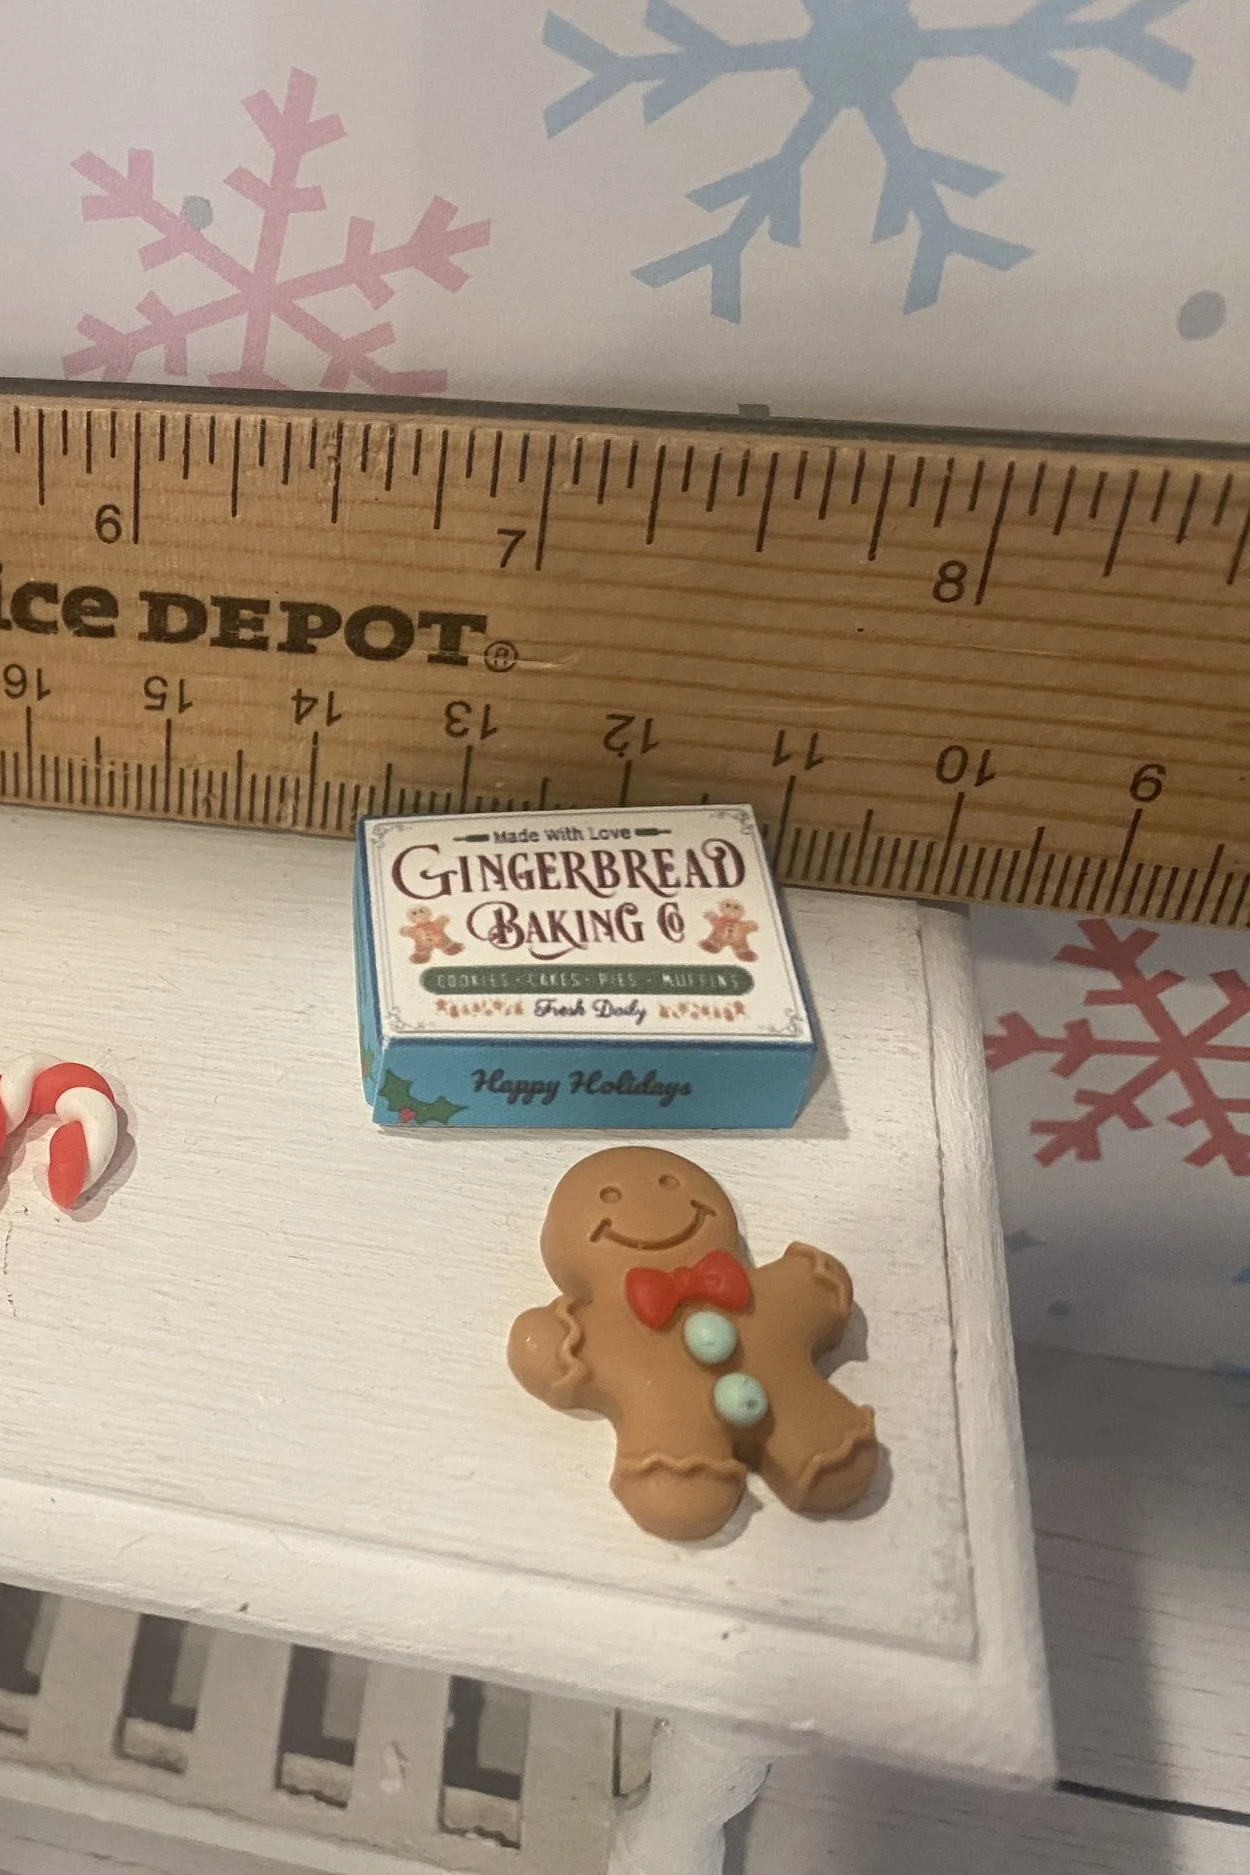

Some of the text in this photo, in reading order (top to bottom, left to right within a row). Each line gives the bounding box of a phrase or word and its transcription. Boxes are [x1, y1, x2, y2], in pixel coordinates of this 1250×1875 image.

[95, 505, 122, 543] 6
[496, 529, 527, 568] 7
[932, 561, 968, 603] 8
[2, 664, 52, 699] 16
[144, 675, 194, 713] 15
[291, 688, 343, 726] 14
[444, 700, 498, 740] 13
[602, 713, 659, 755] 12
[771, 730, 824, 770] 11
[936, 745, 996, 788] 10
[493, 826, 632, 844] Made with Love
[391, 838, 747, 900] GINGERBREAD
[466, 900, 645, 961] BAKING
[437, 974, 739, 988] COOKIES CAKES PIES MUFFINS
[534, 998, 647, 1026] Fresh Daily
[471, 1068, 693, 1108] Happy Holidays
